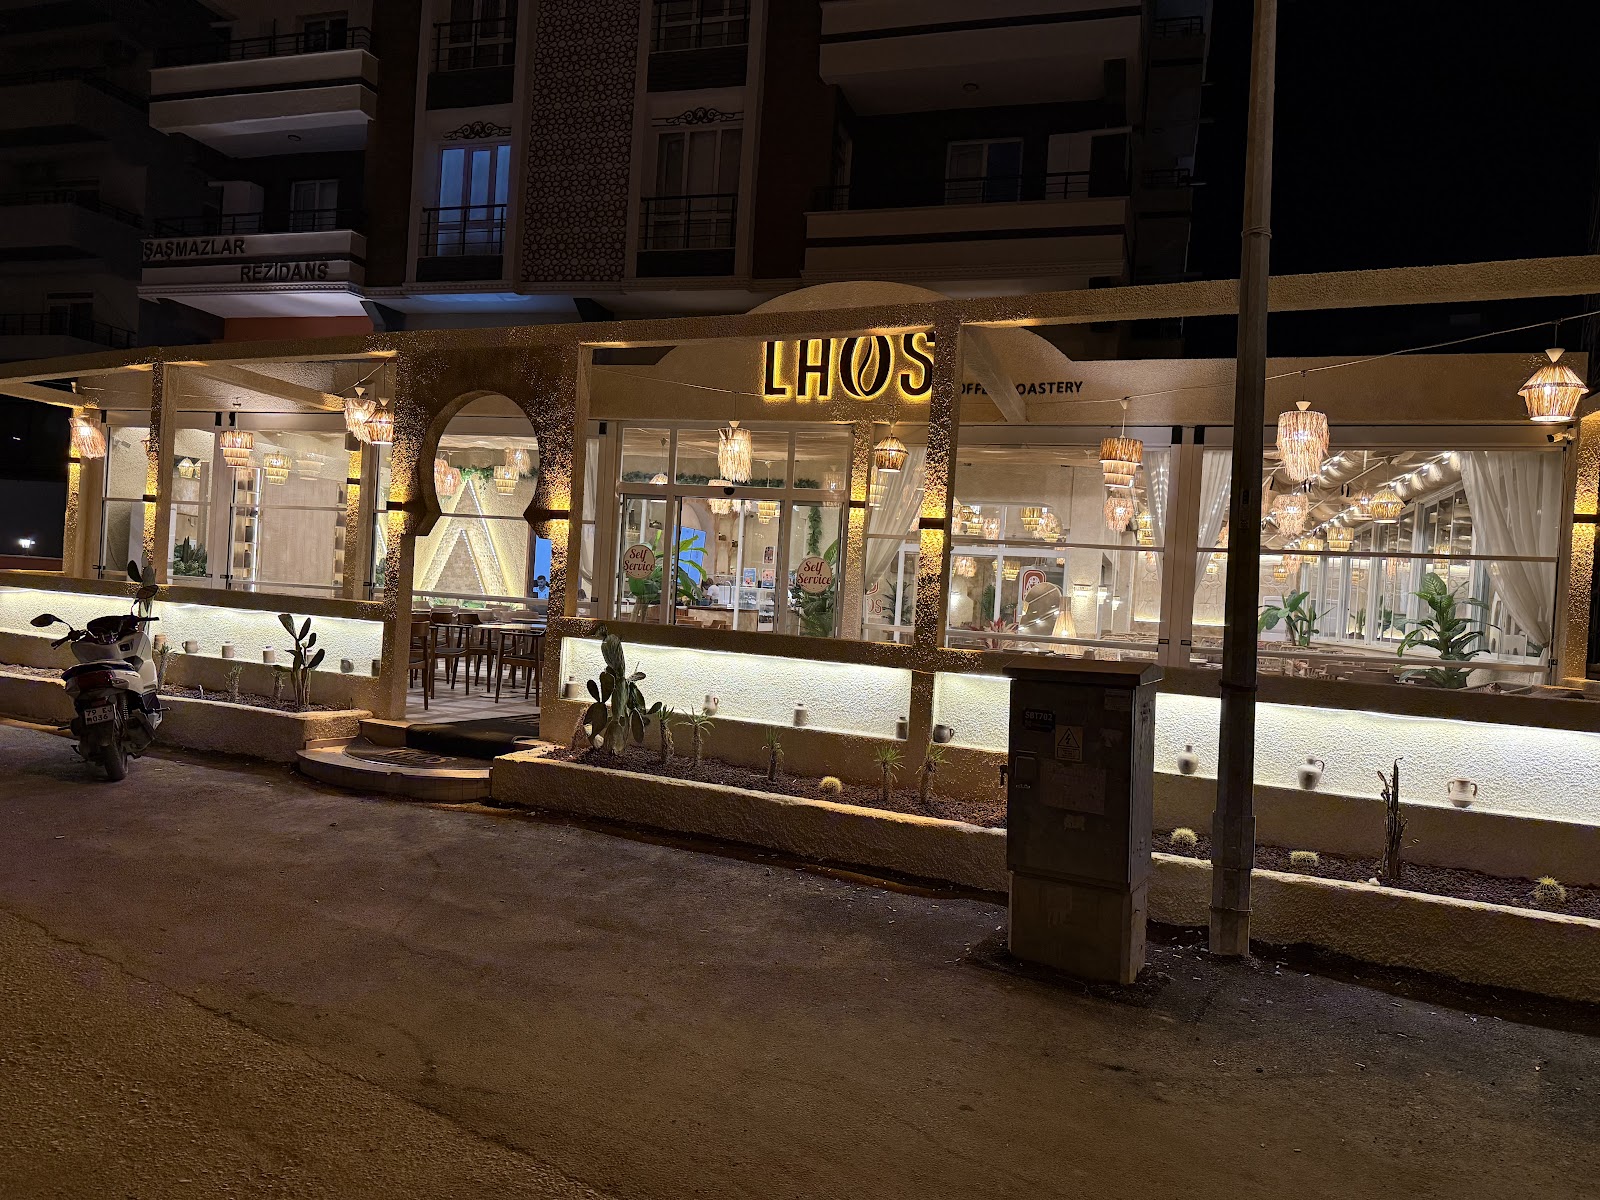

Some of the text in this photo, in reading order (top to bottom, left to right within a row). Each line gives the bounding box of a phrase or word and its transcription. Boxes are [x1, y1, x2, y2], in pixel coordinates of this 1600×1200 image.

[144, 239, 245, 260] ŞAŞMAZLAR
[240, 262, 329, 282] REZİDANS
[1015, 381, 1083, 395] OASTERY
[630, 549, 648, 562] Self
[623, 560, 654, 571] Service
[804, 561, 824, 575] Self
[797, 573, 831, 584] Service
[86, 709, 97, 717] 79
